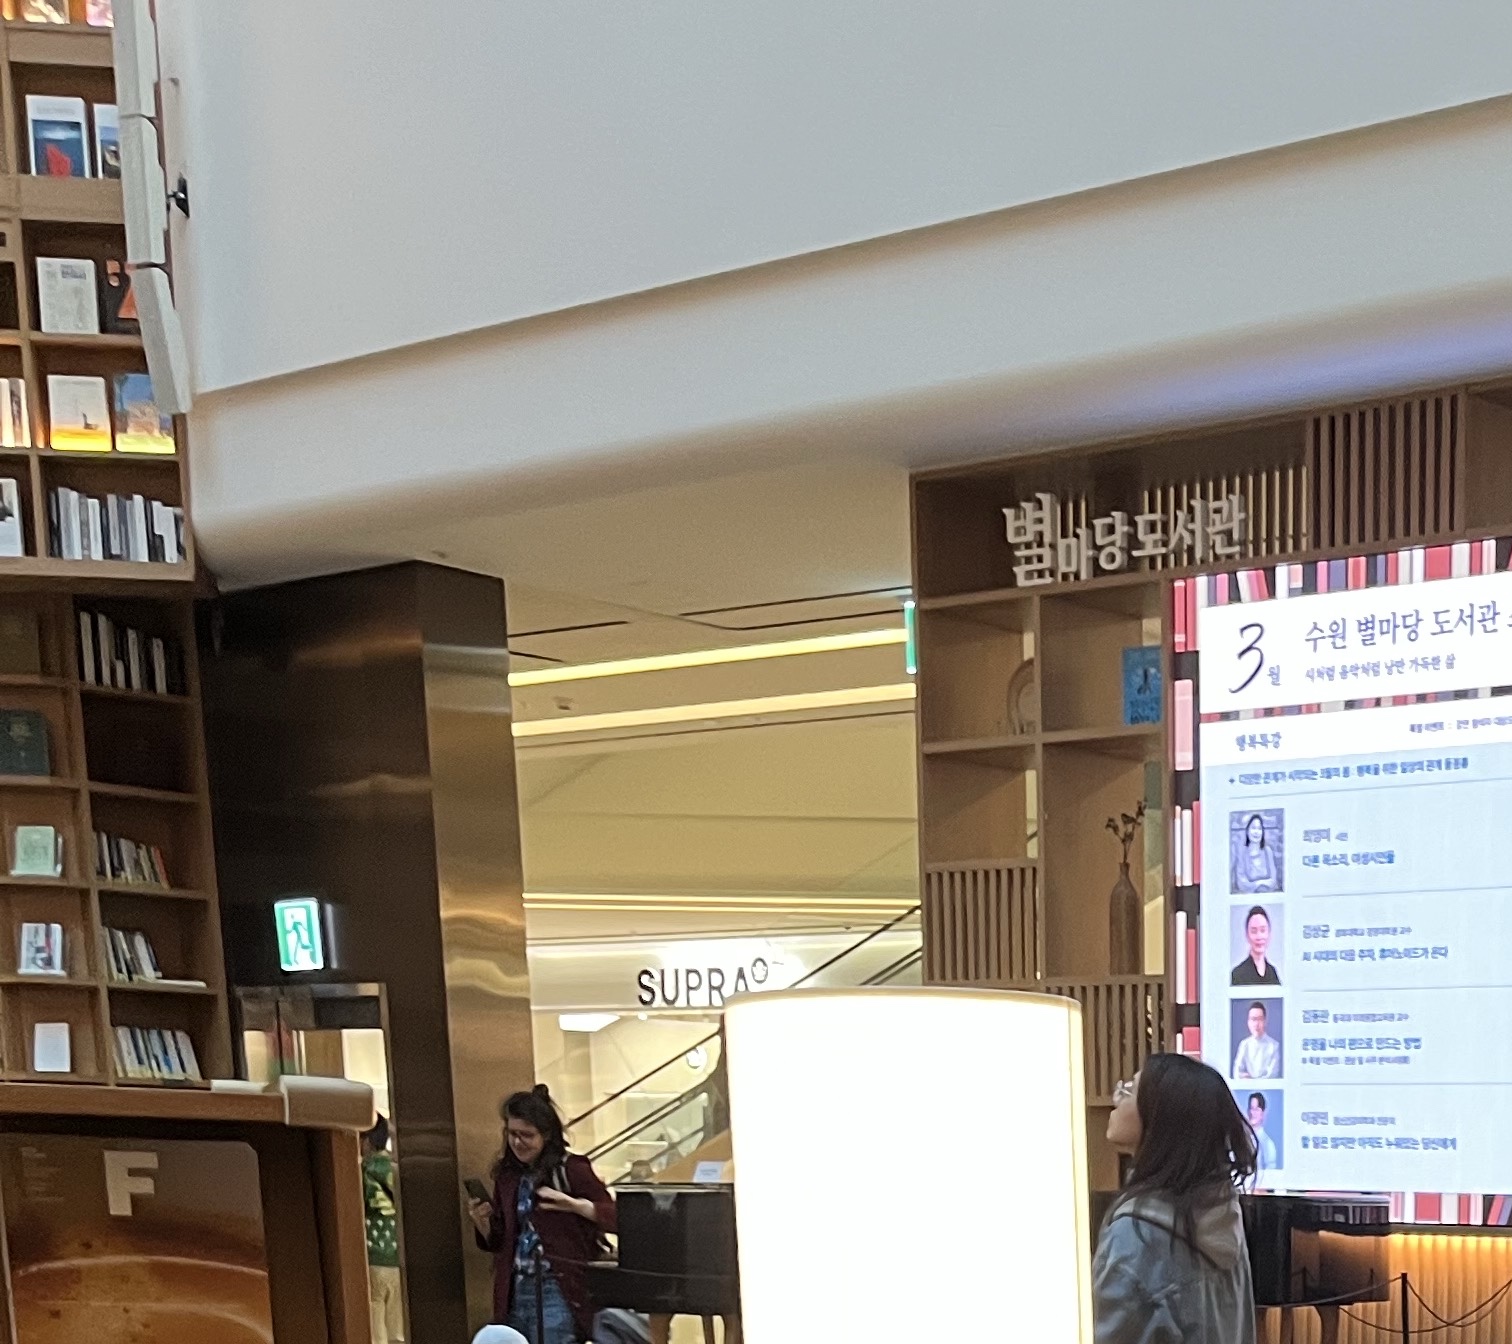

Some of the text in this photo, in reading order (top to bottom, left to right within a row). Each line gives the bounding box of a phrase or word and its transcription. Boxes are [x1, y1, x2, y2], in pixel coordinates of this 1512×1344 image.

[1002, 493, 1245, 587] 별마당도서관
[1228, 622, 1265, 694] 3
[1305, 617, 1347, 653] 수원
[1356, 609, 1424, 647] 별마당
[1430, 600, 1500, 637] 도서관
[103, 1149, 159, 1217] F
